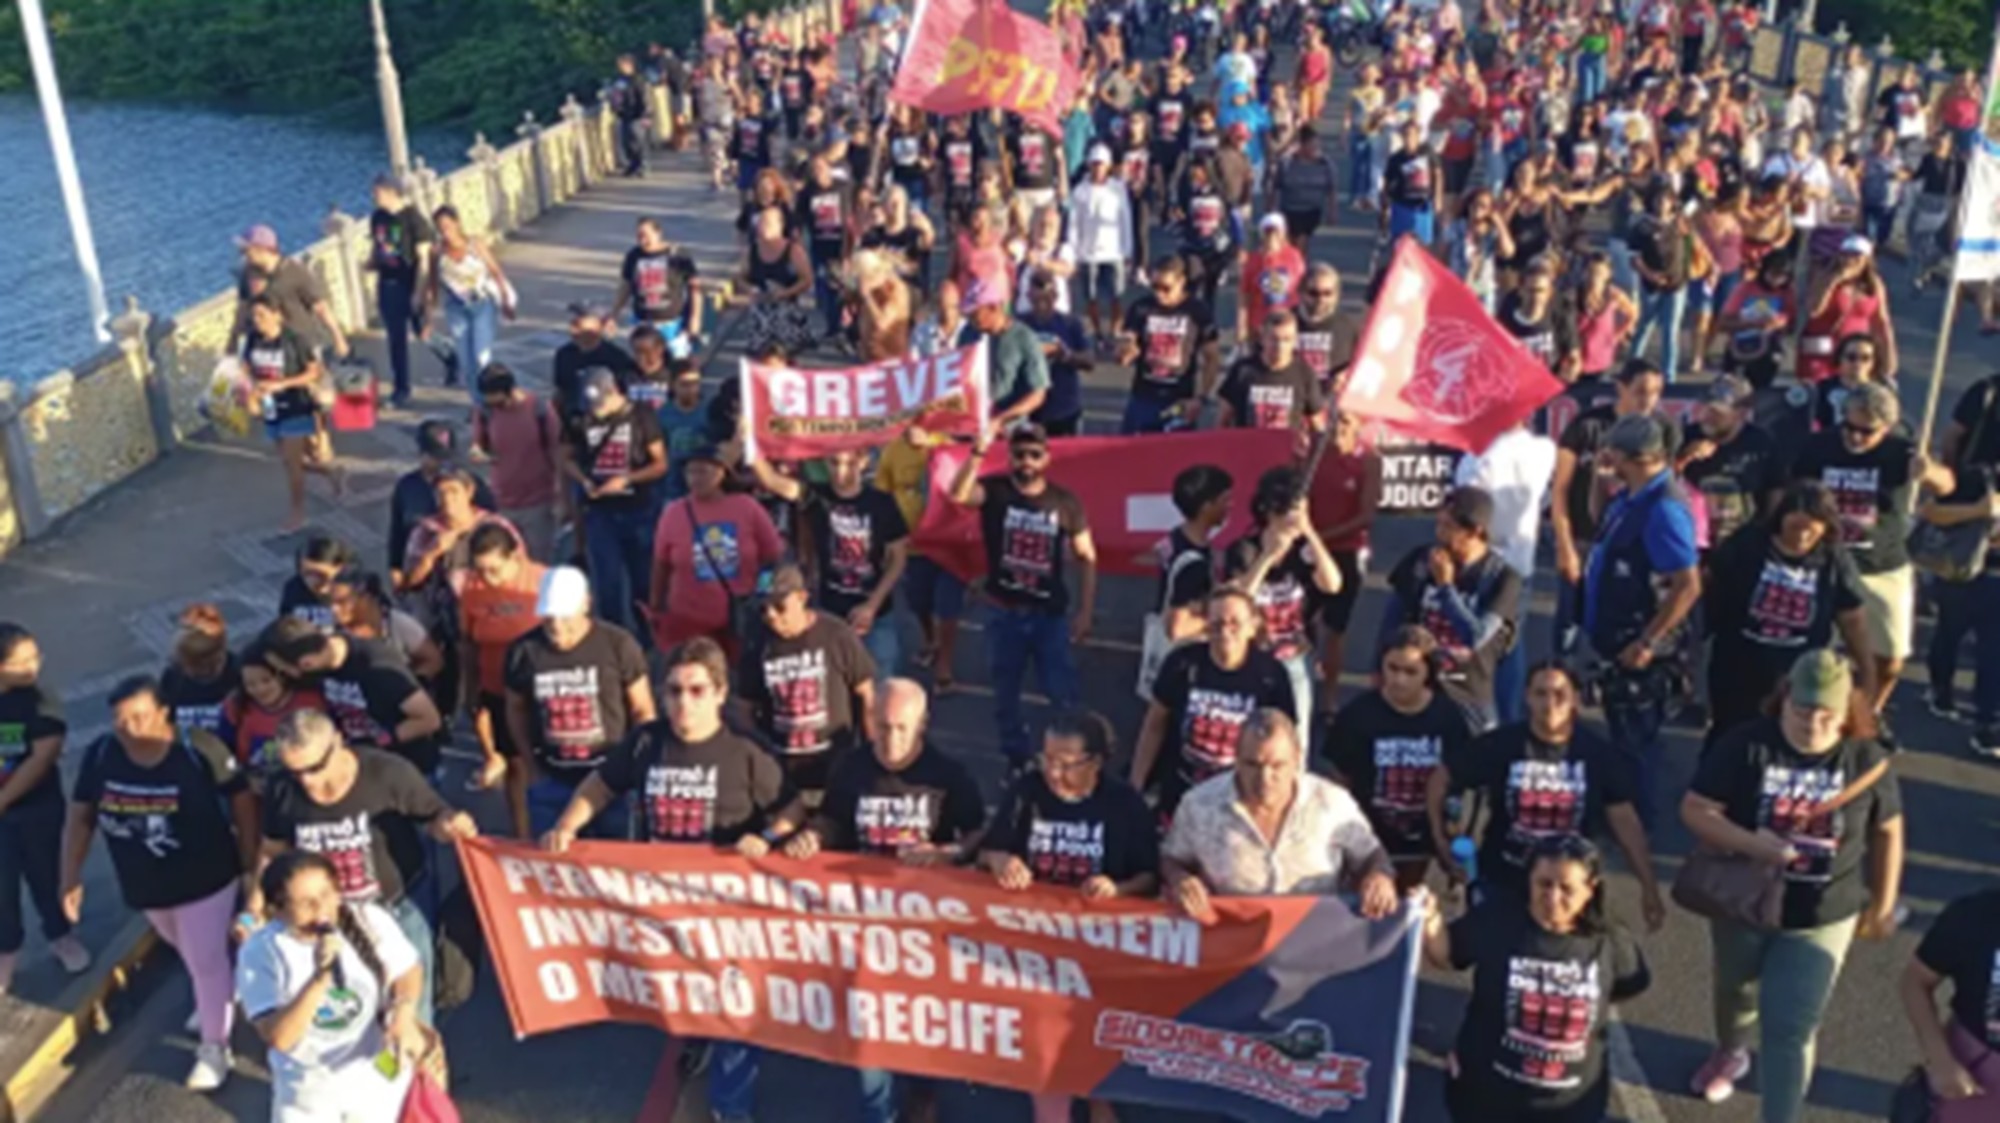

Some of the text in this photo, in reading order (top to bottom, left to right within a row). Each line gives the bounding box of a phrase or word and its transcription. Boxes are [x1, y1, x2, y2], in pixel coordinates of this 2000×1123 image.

[769, 351, 964, 417] GREVE
[517, 905, 1093, 999] INVESTIMENTOS PARA
[537, 957, 1024, 1061] O METRÔ DO RECIFE
